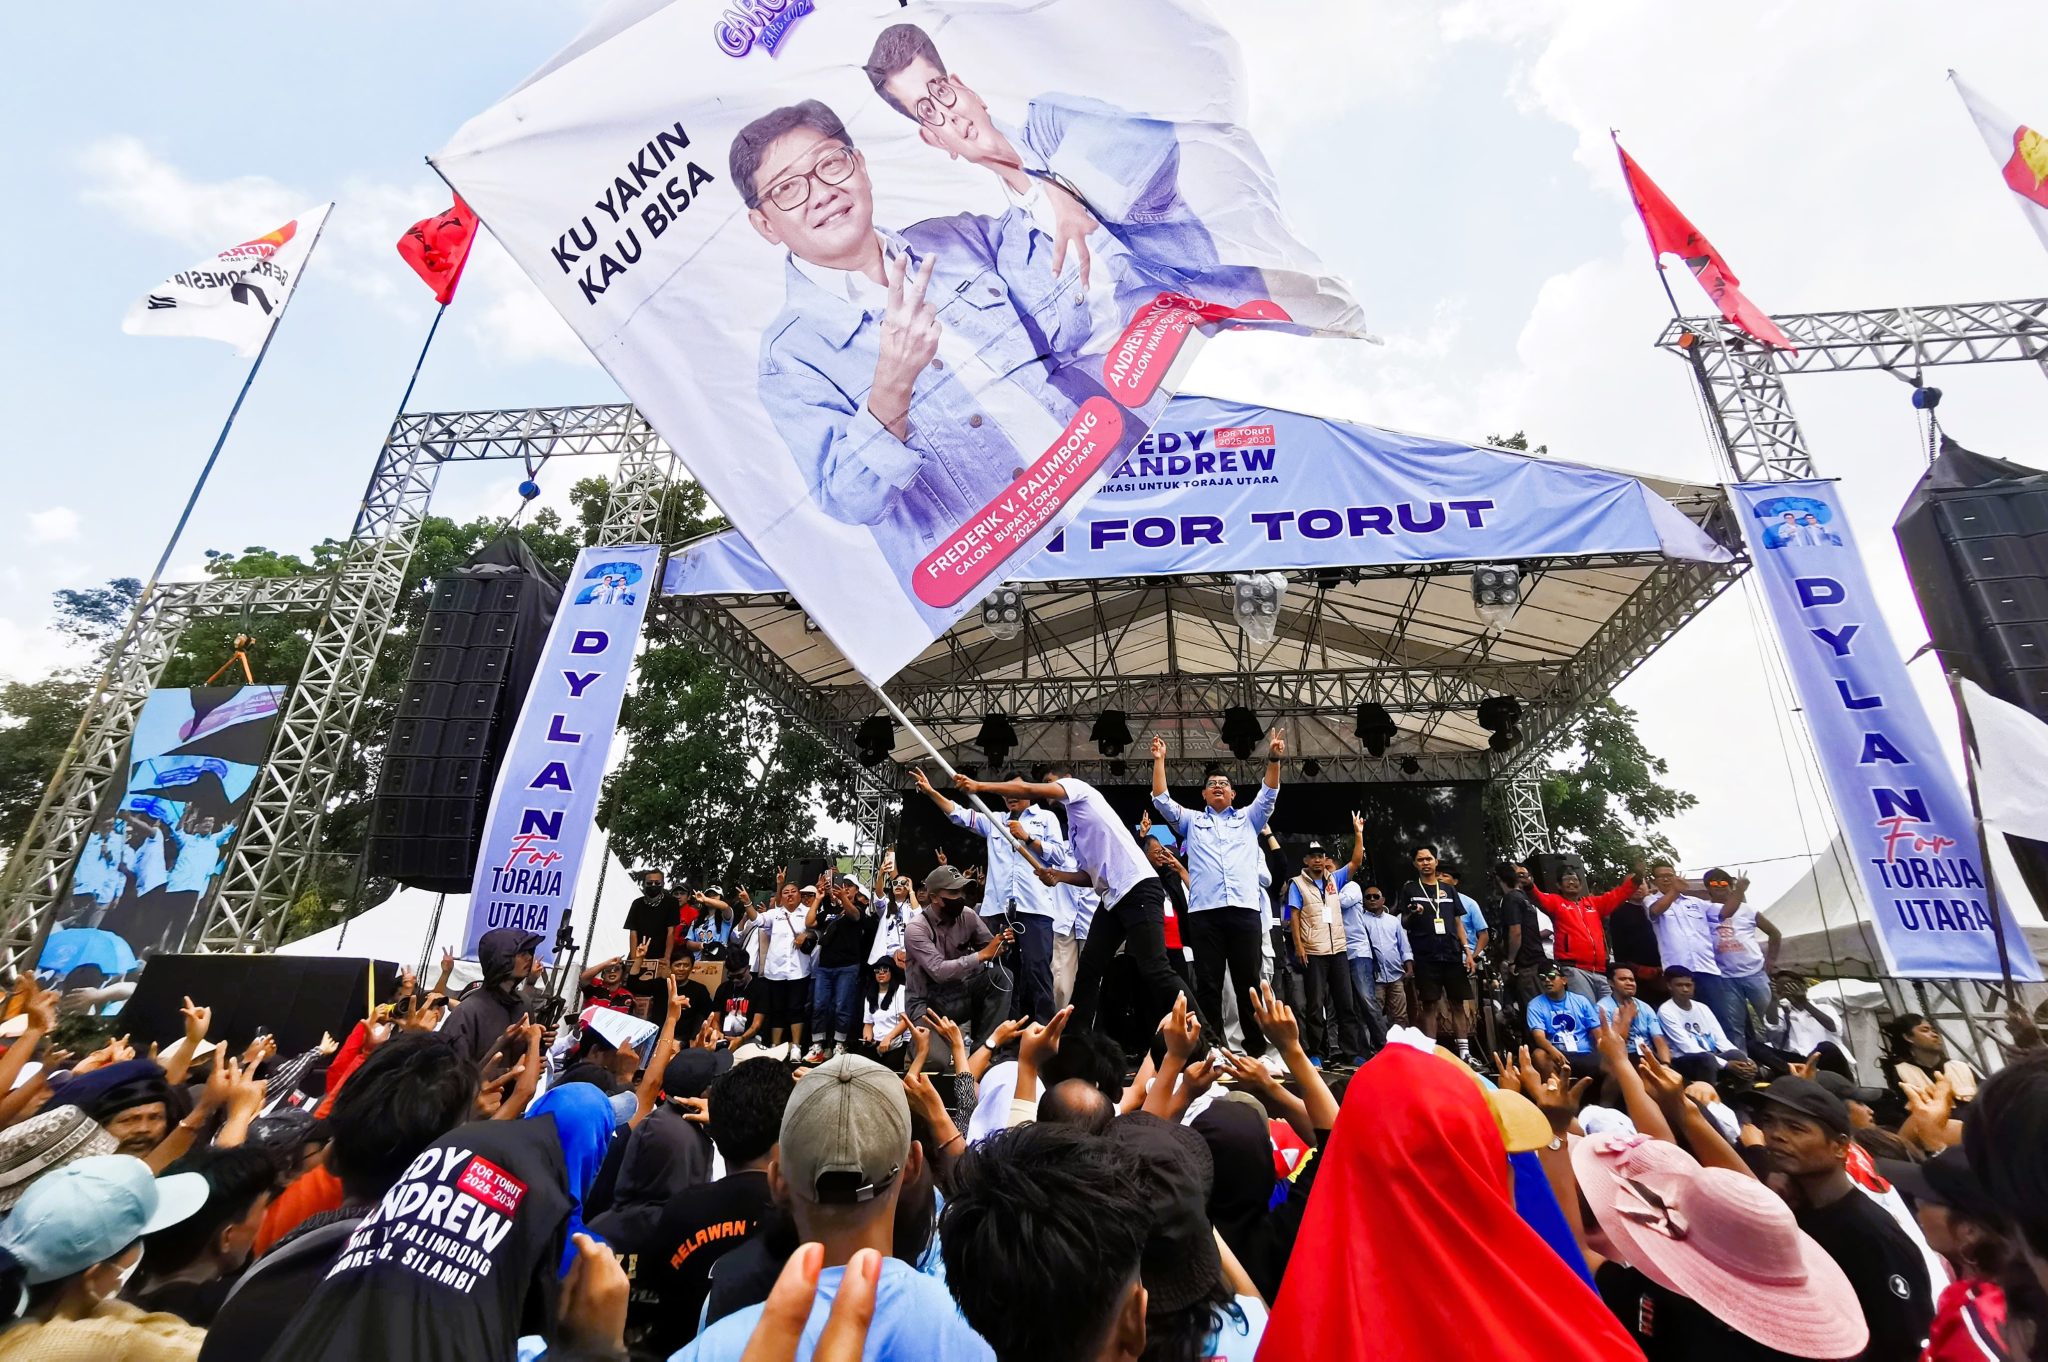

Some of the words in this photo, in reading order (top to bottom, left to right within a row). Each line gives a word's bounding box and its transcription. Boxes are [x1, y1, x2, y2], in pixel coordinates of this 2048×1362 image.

[551, 216, 597, 274] KU
[595, 122, 690, 223] YAKIN
[578, 227, 642, 305] KAU
[641, 161, 715, 239] BISA
[1127, 351, 1154, 389] CALON
[1146, 323, 1168, 352] WAKIL
[1138, 430, 1207, 455] EDY
[1217, 430, 1236, 438] FOR
[1239, 427, 1271, 436] TORUT
[1218, 436, 1271, 446] 2025-2030
[1111, 449, 1276, 478] ANDREW
[1139, 480, 1180, 491] UNTUK
[1183, 477, 1233, 488] TORAJA
[1237, 475, 1279, 485] UTARA
[926, 511, 1004, 579] FREDERIK
[1001, 498, 1021, 514] V.
[1017, 411, 1098, 501] PALIMBONG
[955, 543, 993, 576] CALON
[994, 509, 1030, 543] BUPATI
[1028, 474, 1068, 513] TORAJA
[1066, 440, 1097, 475] UTARA
[1013, 496, 1060, 543] 2025-2030
[1091, 515, 1224, 550] FOR
[1252, 499, 1495, 541] TORUT
[504, 833, 563, 872] For
[1877, 816, 1955, 863] For
[492, 867, 562, 896] TORAJA
[1872, 858, 1985, 889] TORAJA
[487, 901, 549, 931] UTARA
[1895, 899, 1996, 931] UTARA
[463, 1173, 516, 1211] 2025-2030
[470, 1162, 493, 1180] FOR
[495, 1175, 524, 1199] TORUT
[391, 1221, 492, 1276] PALIMBONG
[669, 1219, 747, 1270] RELAWAN
[401, 1247, 477, 1293] SILAMBI
